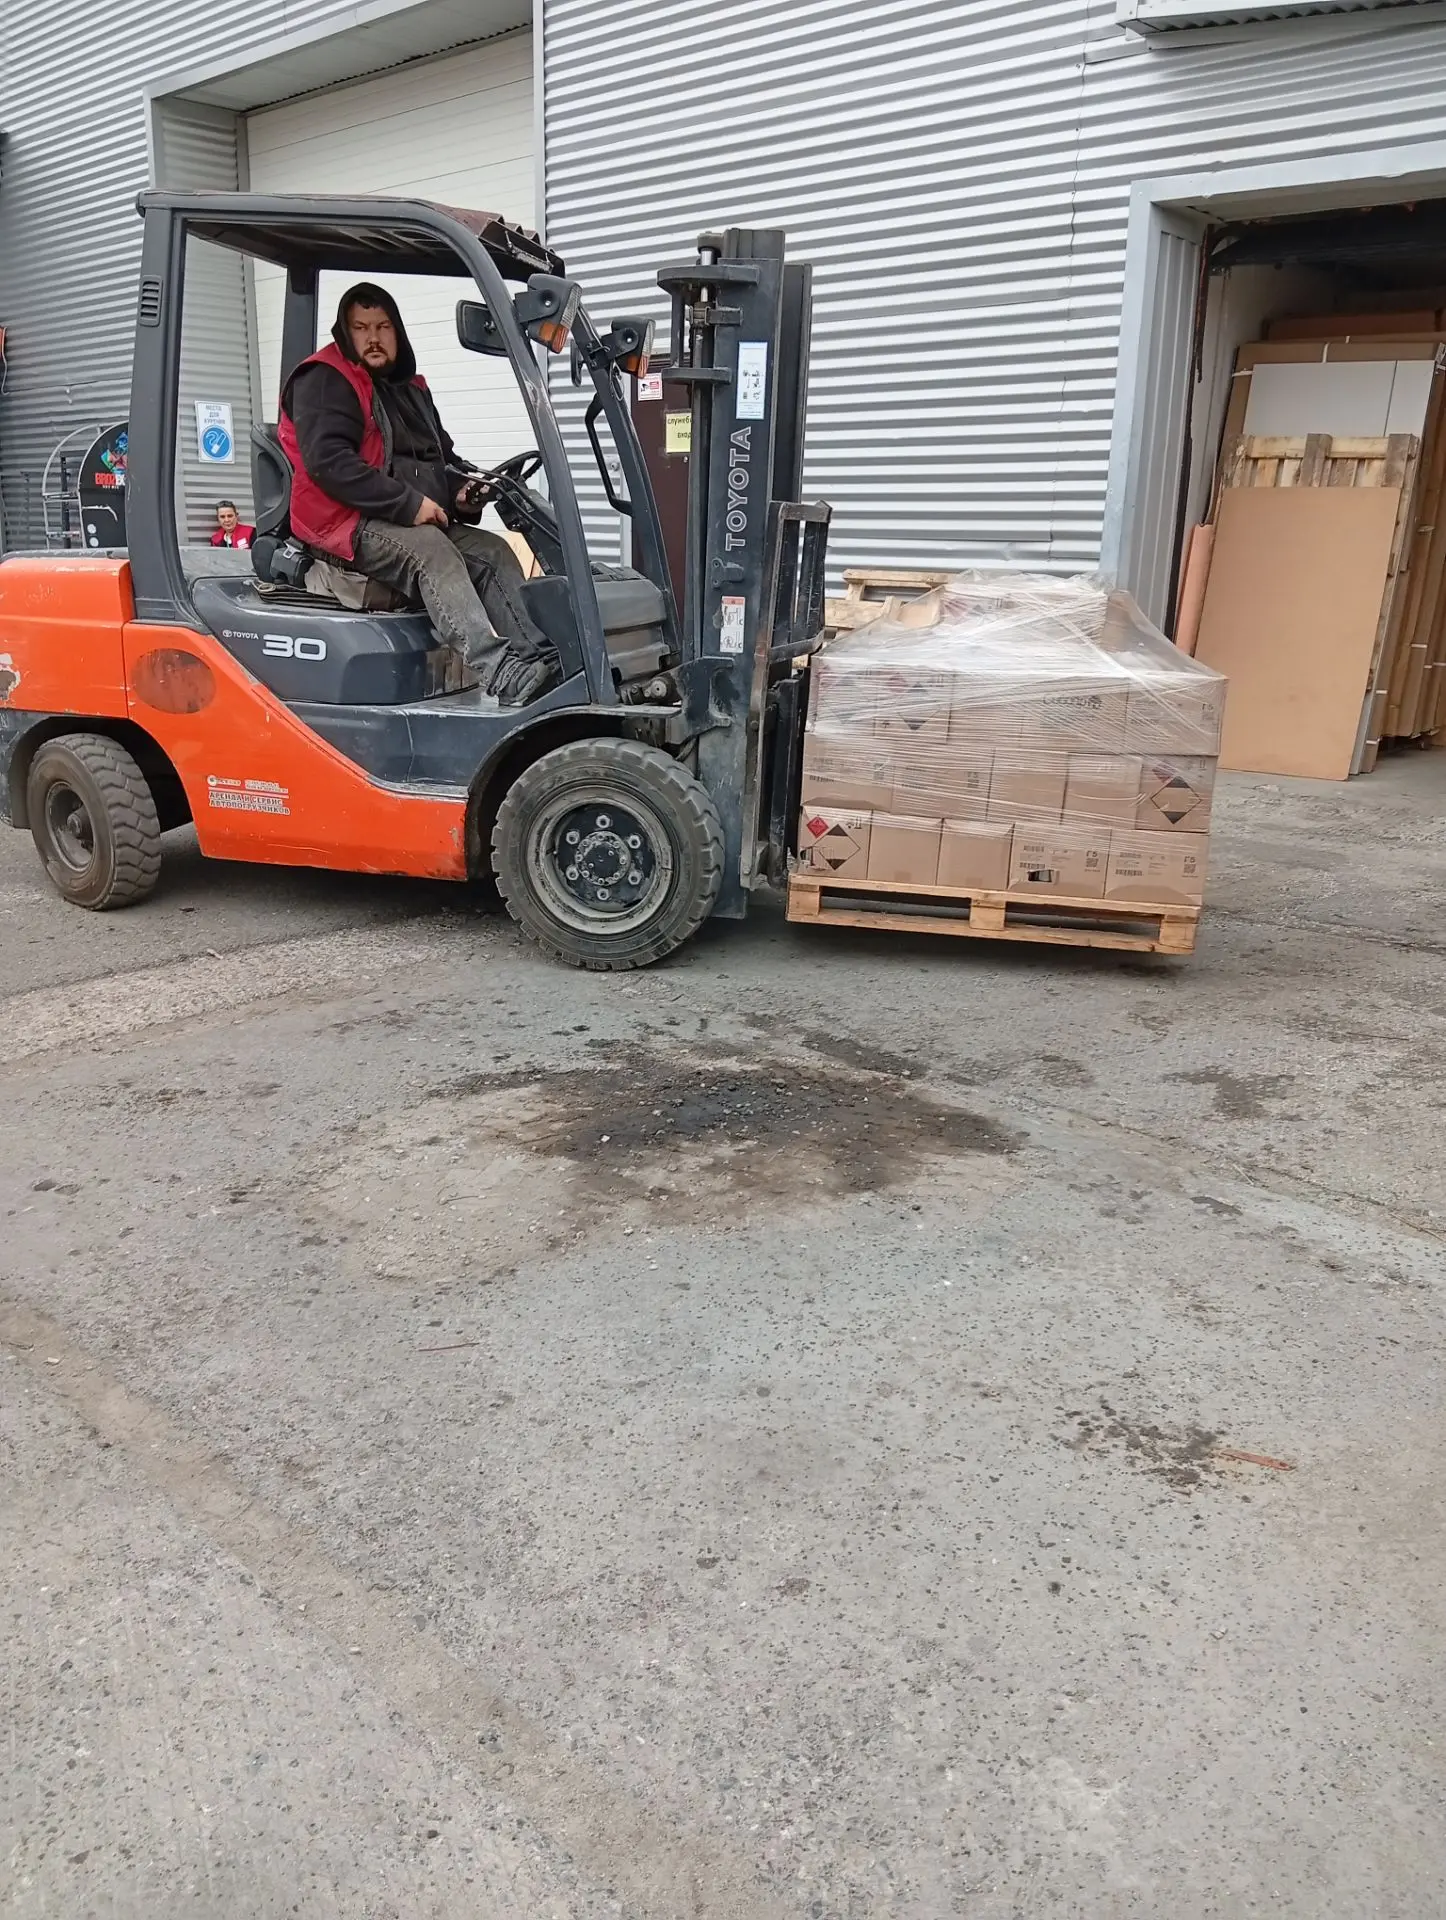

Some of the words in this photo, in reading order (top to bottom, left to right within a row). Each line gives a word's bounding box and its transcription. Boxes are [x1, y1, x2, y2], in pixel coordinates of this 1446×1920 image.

[725, 426, 752, 551] TOYOTA
[232, 631, 259, 639] TOYOTA
[262, 633, 327, 661] 30
[210, 791, 242, 801] АРЕНДА
[252, 796, 282, 806] СЕРВИС
[210, 800, 290, 814] АВТОПОГРУЗЧИКОВ
